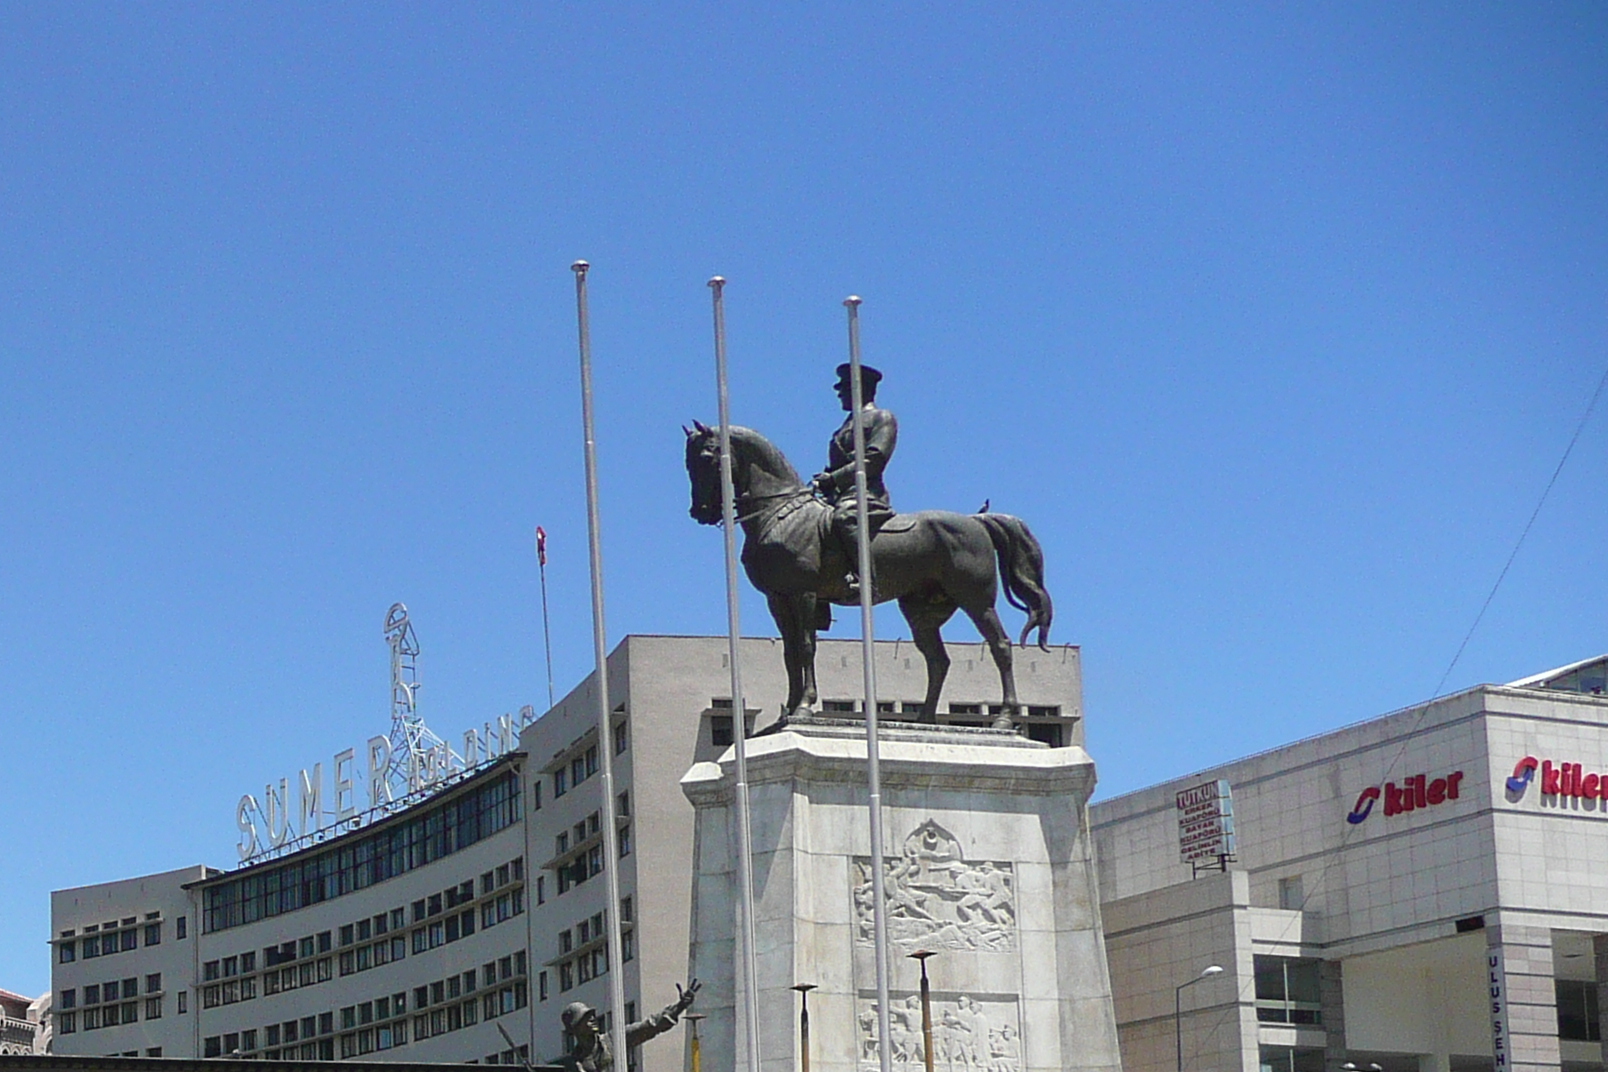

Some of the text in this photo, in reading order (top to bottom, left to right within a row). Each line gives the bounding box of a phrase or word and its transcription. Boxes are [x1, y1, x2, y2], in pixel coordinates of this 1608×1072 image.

[1177, 782, 1218, 809] TUTKUN
[1383, 771, 1463, 817] kiler
[1185, 821, 1215, 834] BAYAN
[1488, 955, 1501, 1014] ULUS
